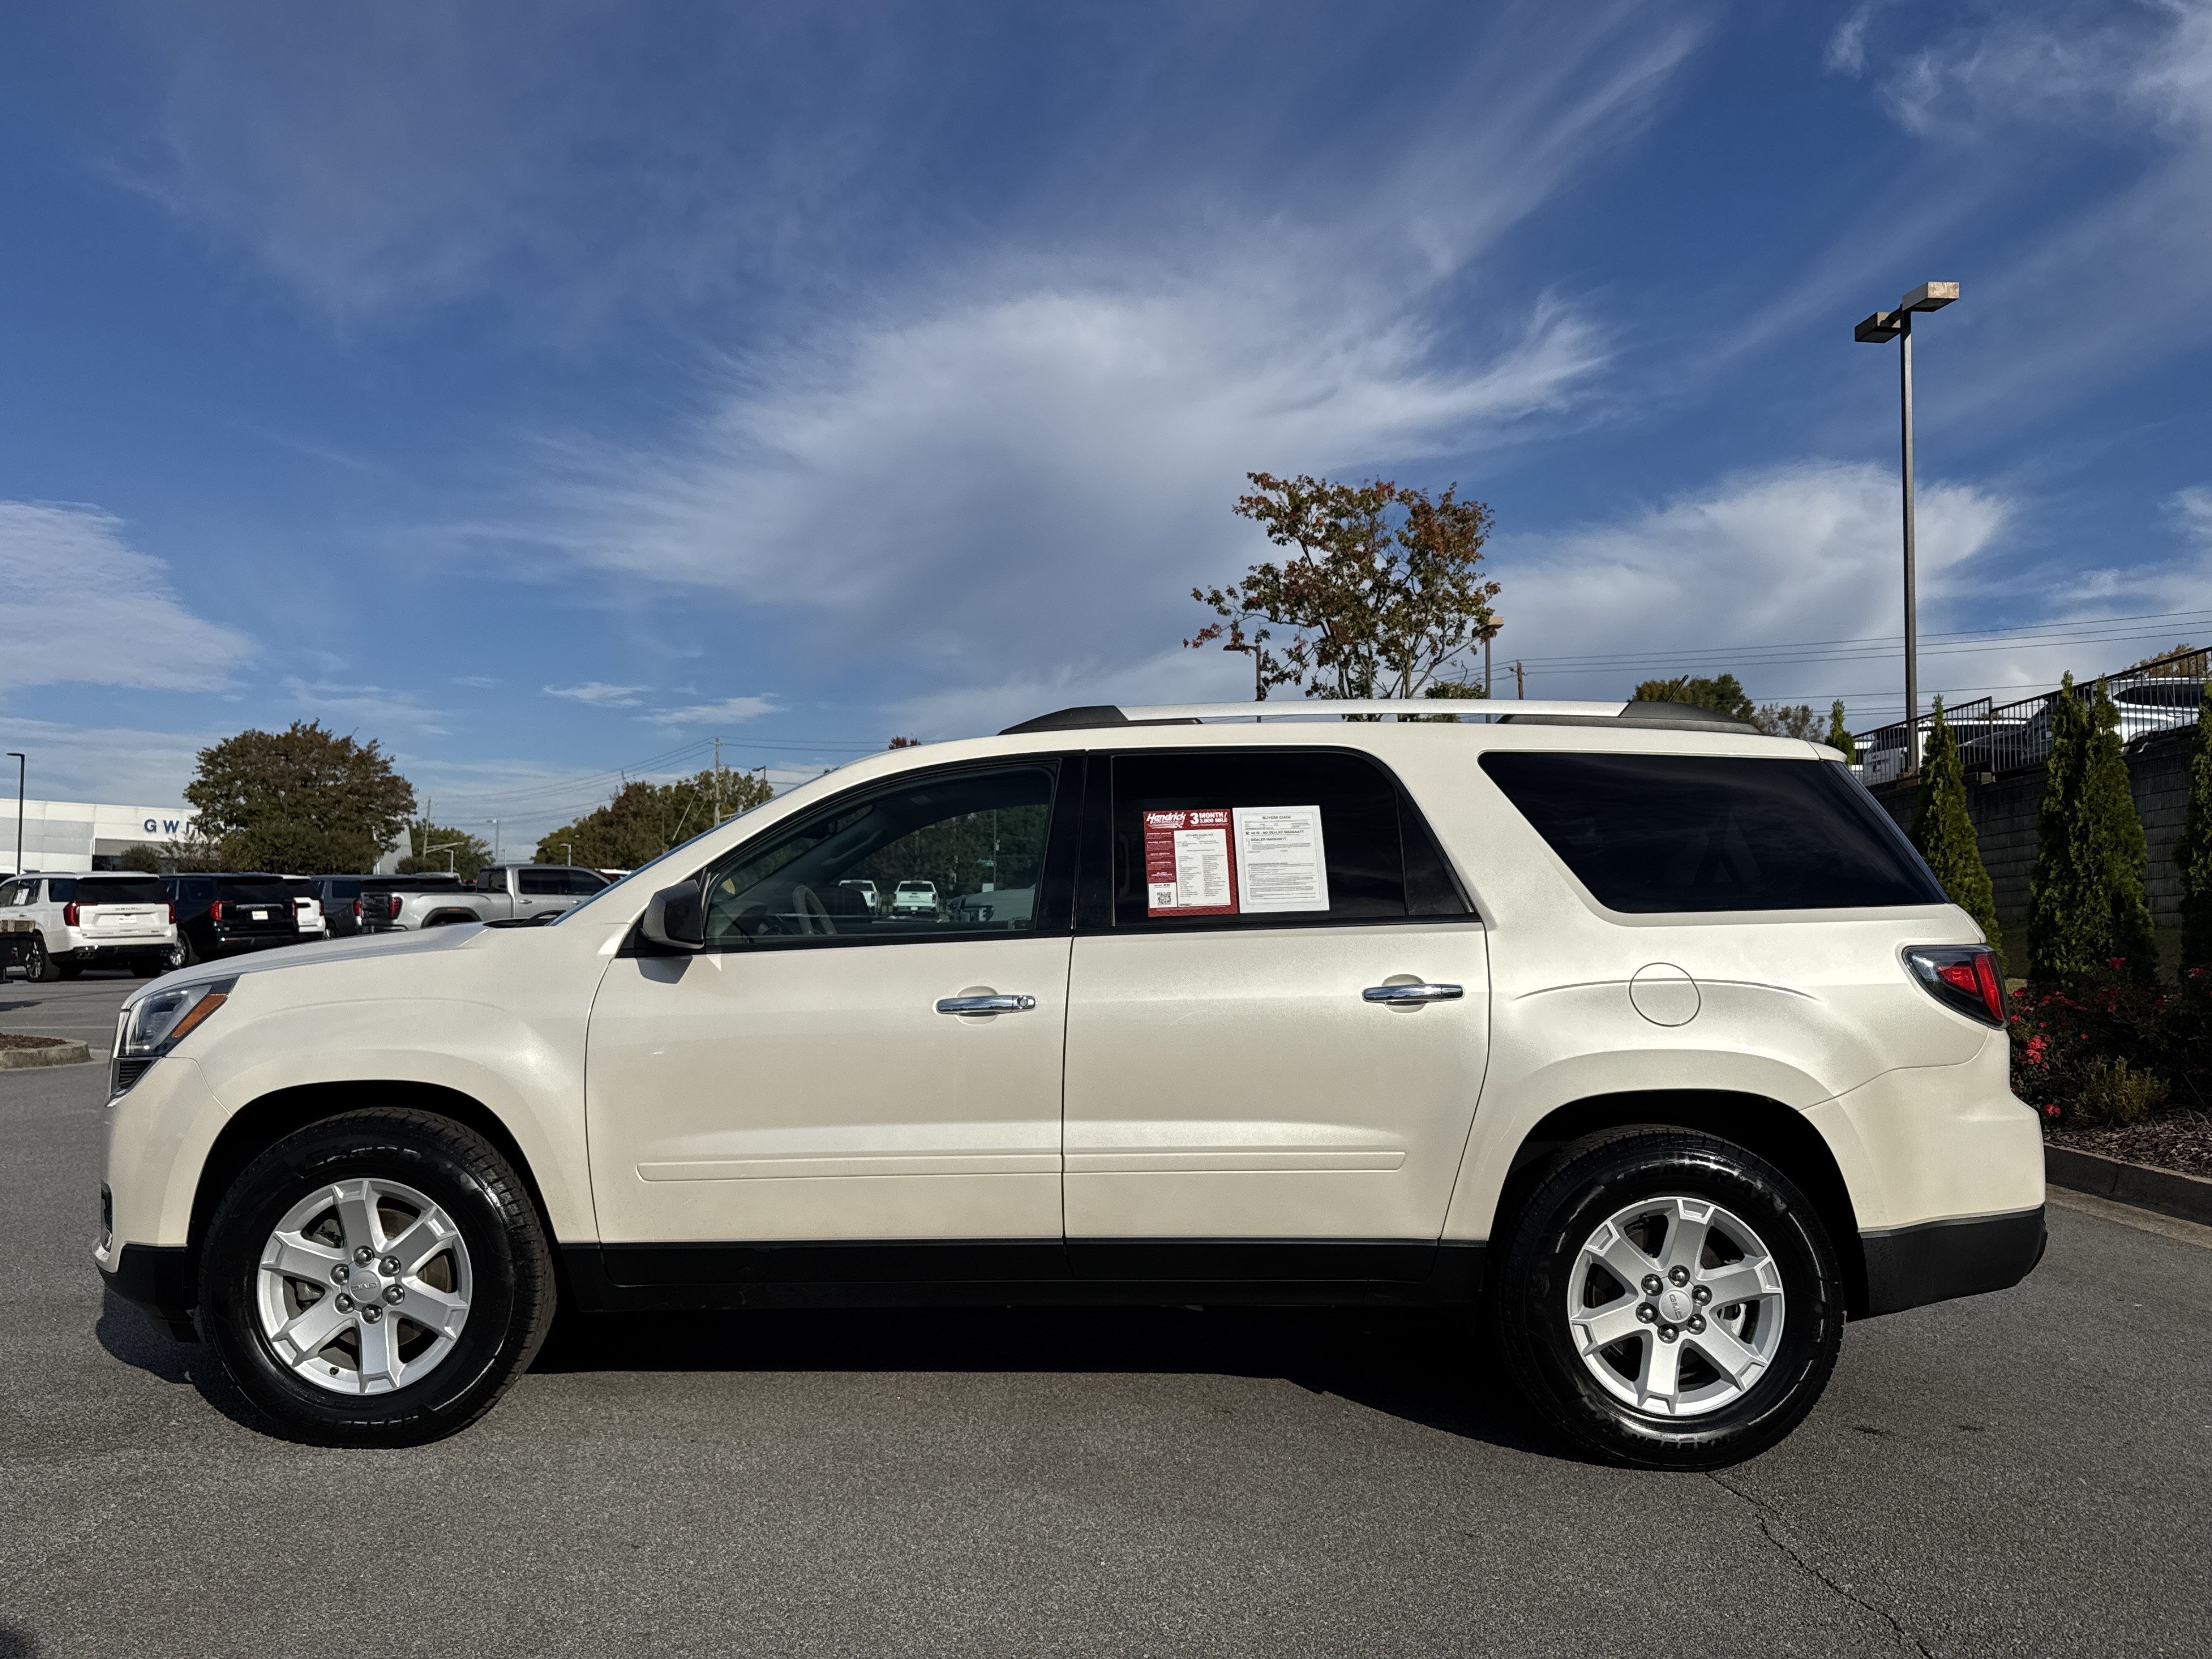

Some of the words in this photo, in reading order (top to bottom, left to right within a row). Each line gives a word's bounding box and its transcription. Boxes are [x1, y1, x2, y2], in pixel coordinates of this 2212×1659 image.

[1147, 812, 1186, 825] Hendrick
[1190, 812, 1199, 825] 3
[1669, 1294, 1683, 1319] GMC
